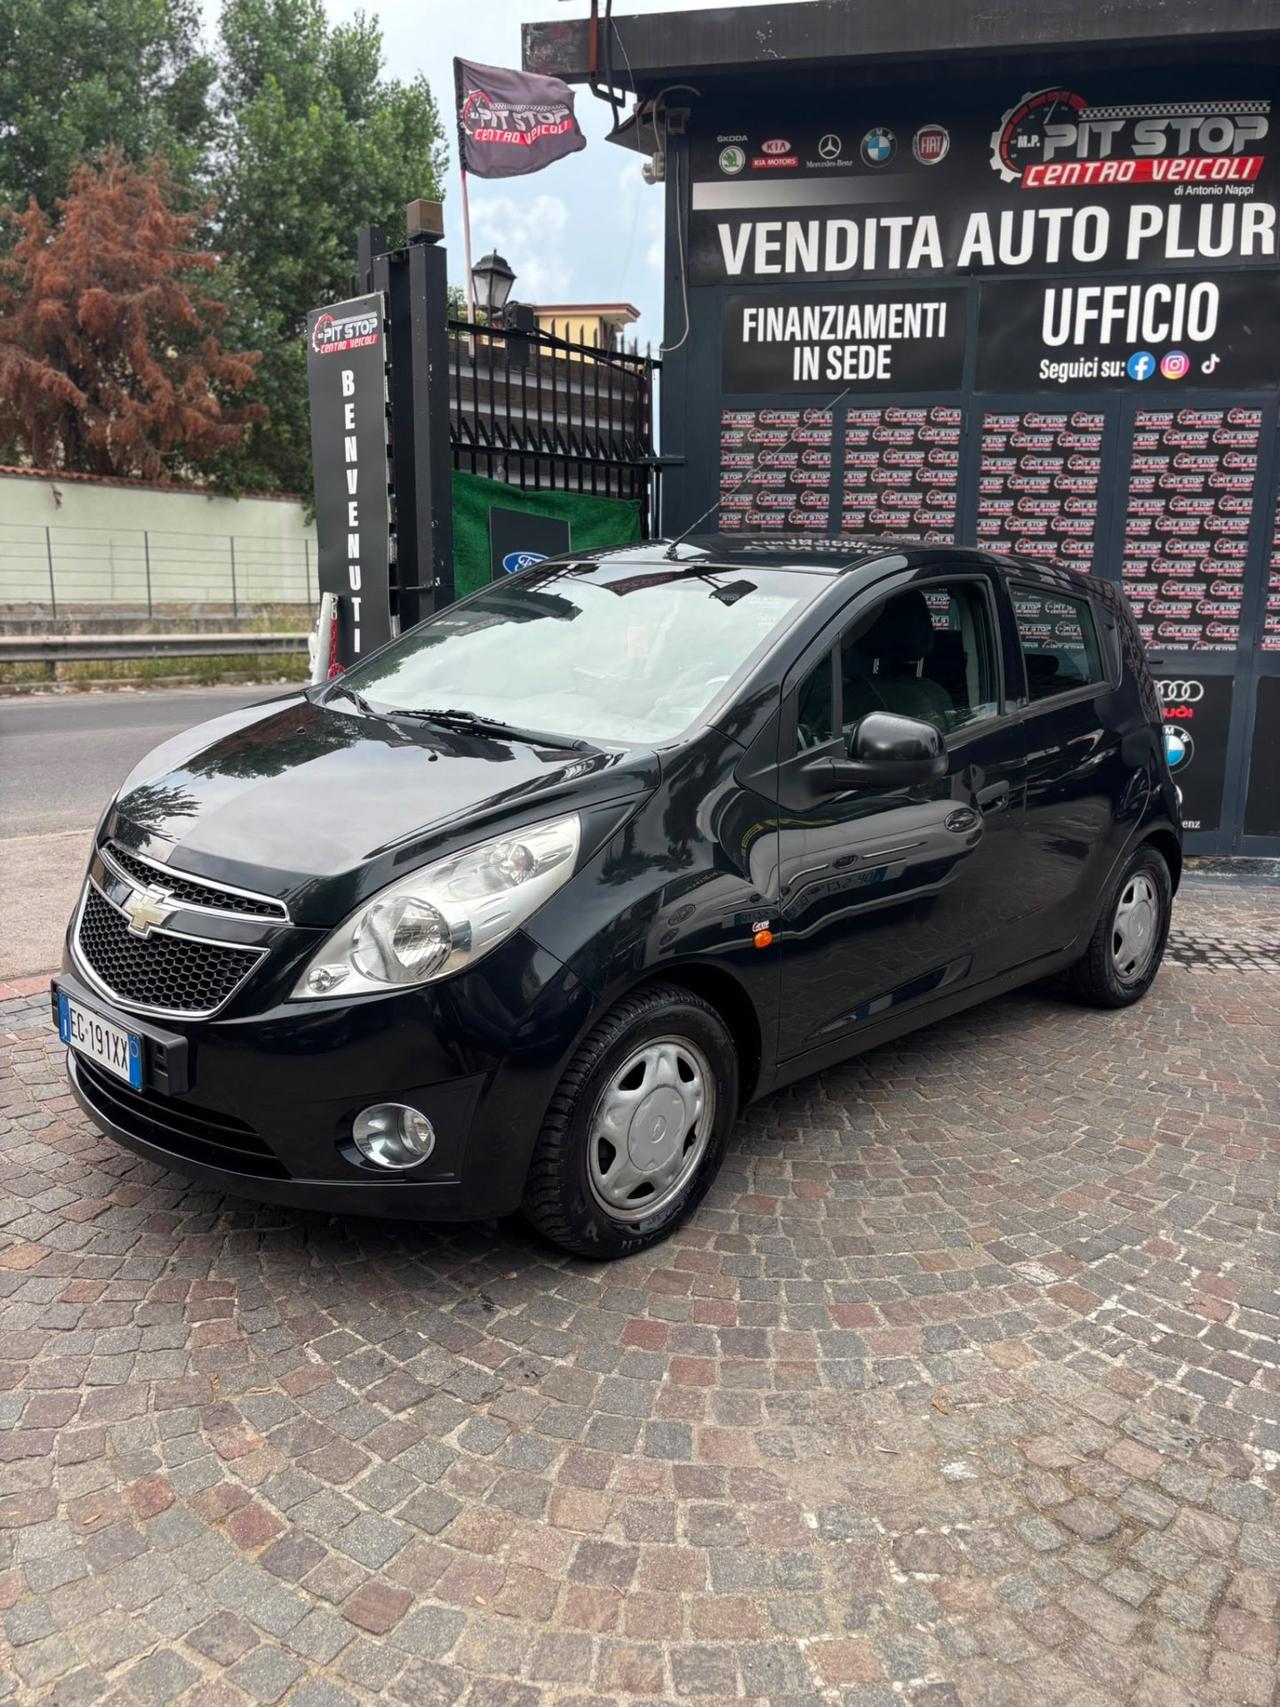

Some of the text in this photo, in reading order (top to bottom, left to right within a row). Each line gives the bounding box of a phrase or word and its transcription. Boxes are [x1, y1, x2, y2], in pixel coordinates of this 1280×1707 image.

[478, 108, 570, 131] PIT STOP
[766, 142, 786, 152] KIA
[920, 136, 943, 154] FIAT
[1043, 119, 1126, 162] PIT
[1131, 115, 1269, 156] STOP
[753, 158, 796, 167] KIA MOTORS
[1174, 184, 1254, 196] di Antonio Nappi
[717, 203, 1276, 275] VENDITA AUTO PLUR
[742, 302, 947, 342] FINANZIAMENTI
[1042, 282, 1220, 347] UFFICIO
[324, 318, 378, 343] PIT STOP
[793, 344, 892, 381] IN SEDE
[1039, 357, 1126, 383] Seguici su:
[341, 370, 361, 653] BENVENUTI
[1163, 705, 1194, 718] udi
